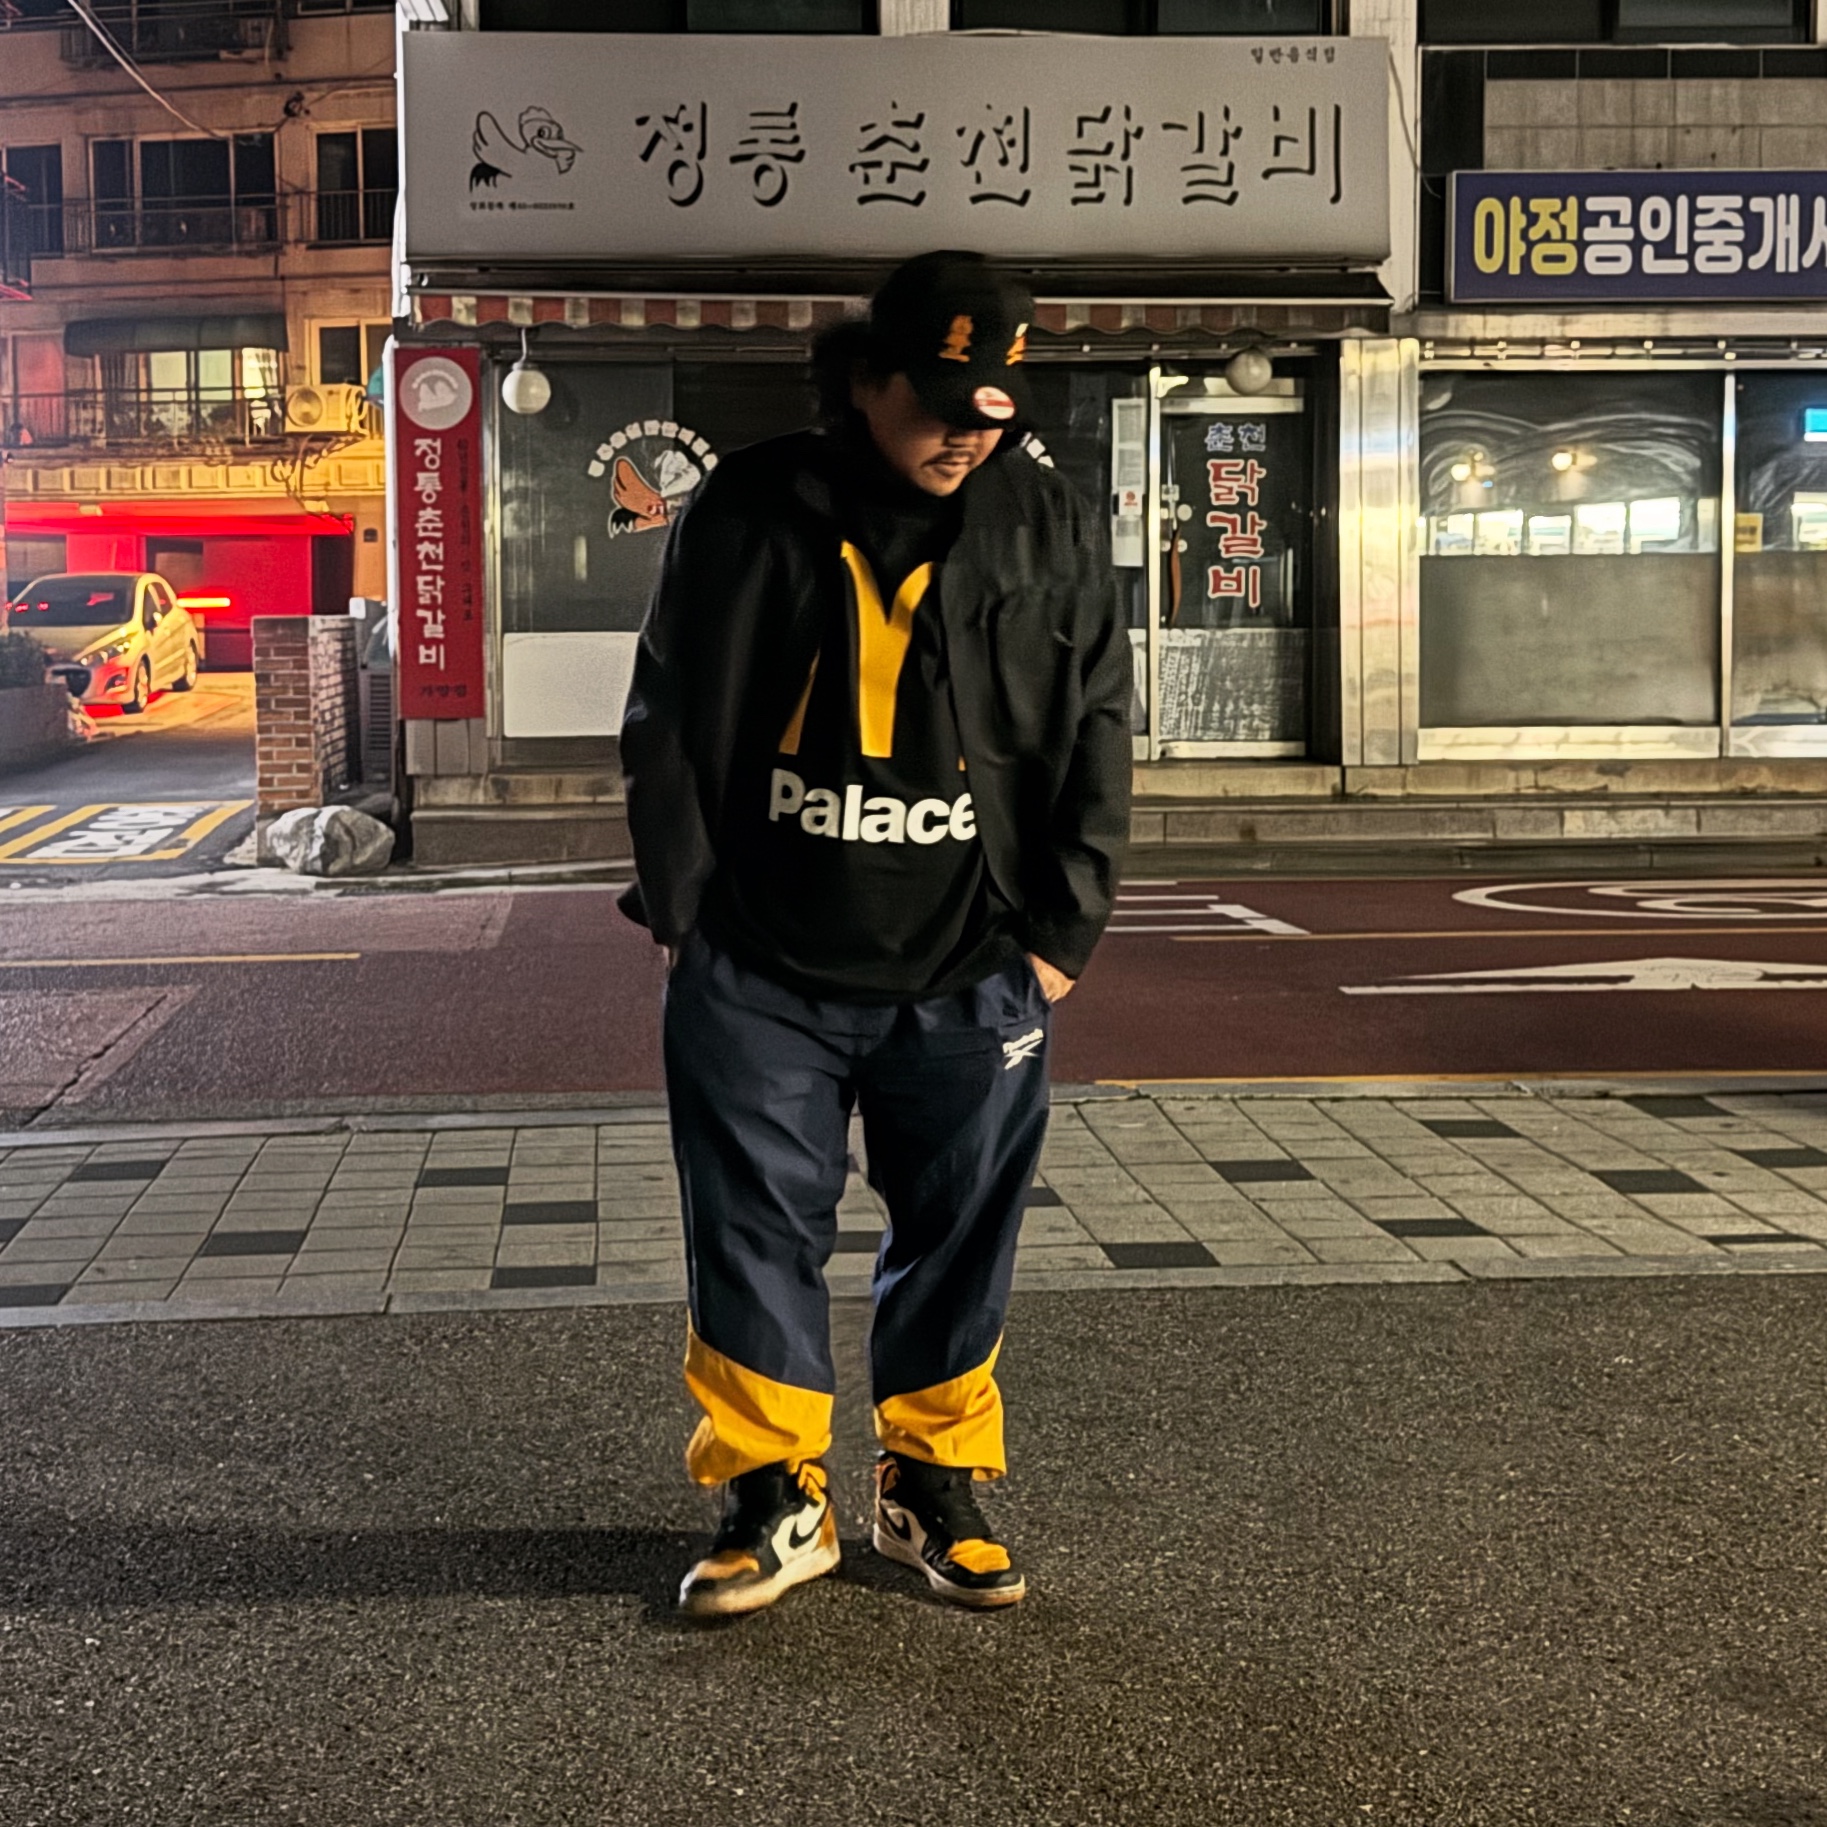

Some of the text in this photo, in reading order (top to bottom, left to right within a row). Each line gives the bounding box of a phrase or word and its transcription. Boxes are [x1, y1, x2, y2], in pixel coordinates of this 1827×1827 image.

[848, 101, 1031, 208] 춘천
[1067, 104, 1342, 207] 닭갈비
[1204, 422, 1267, 453] 춘천
[1206, 458, 1267, 608] 닭갈비
[769, 768, 977, 844] Palace
